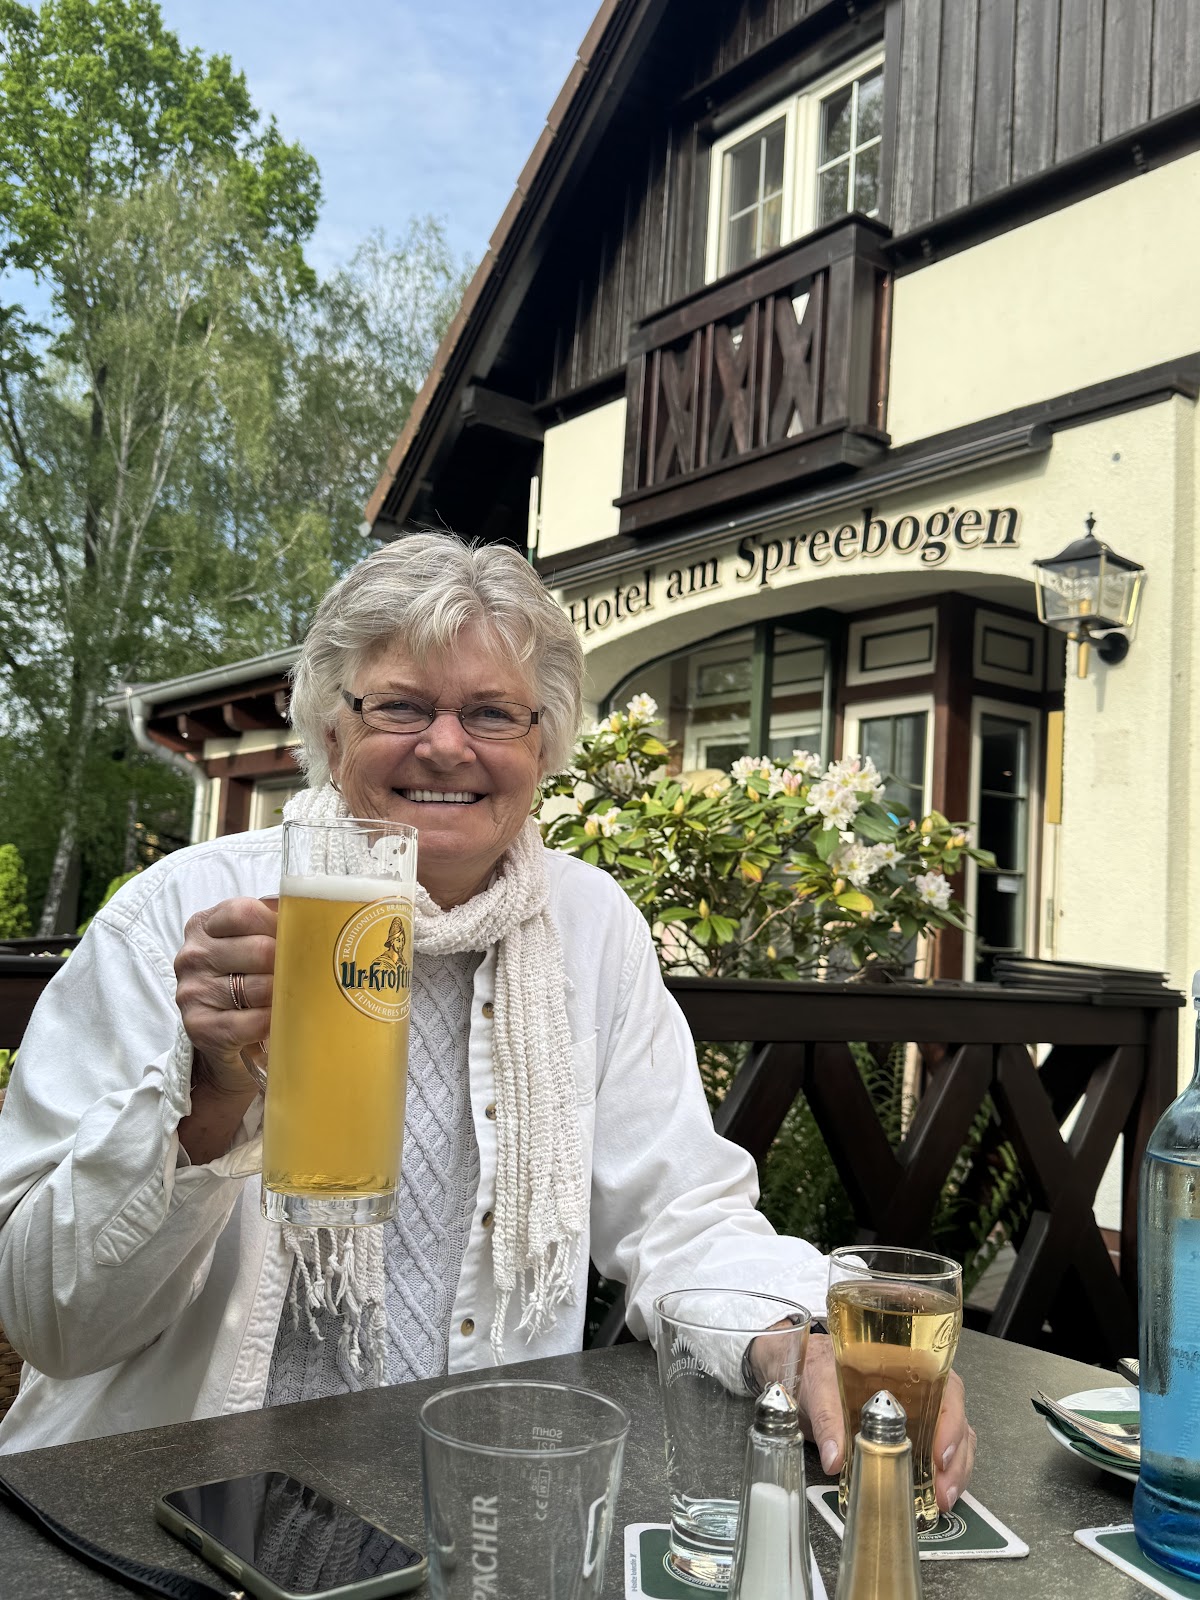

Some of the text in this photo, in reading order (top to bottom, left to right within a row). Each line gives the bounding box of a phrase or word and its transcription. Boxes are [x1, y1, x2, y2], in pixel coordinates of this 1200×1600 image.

[569, 505, 1021, 636] Hotel am Spreebogen
[342, 907, 385, 959] TRADITIONELLES
[354, 991, 399, 1017] FEINHERBES
